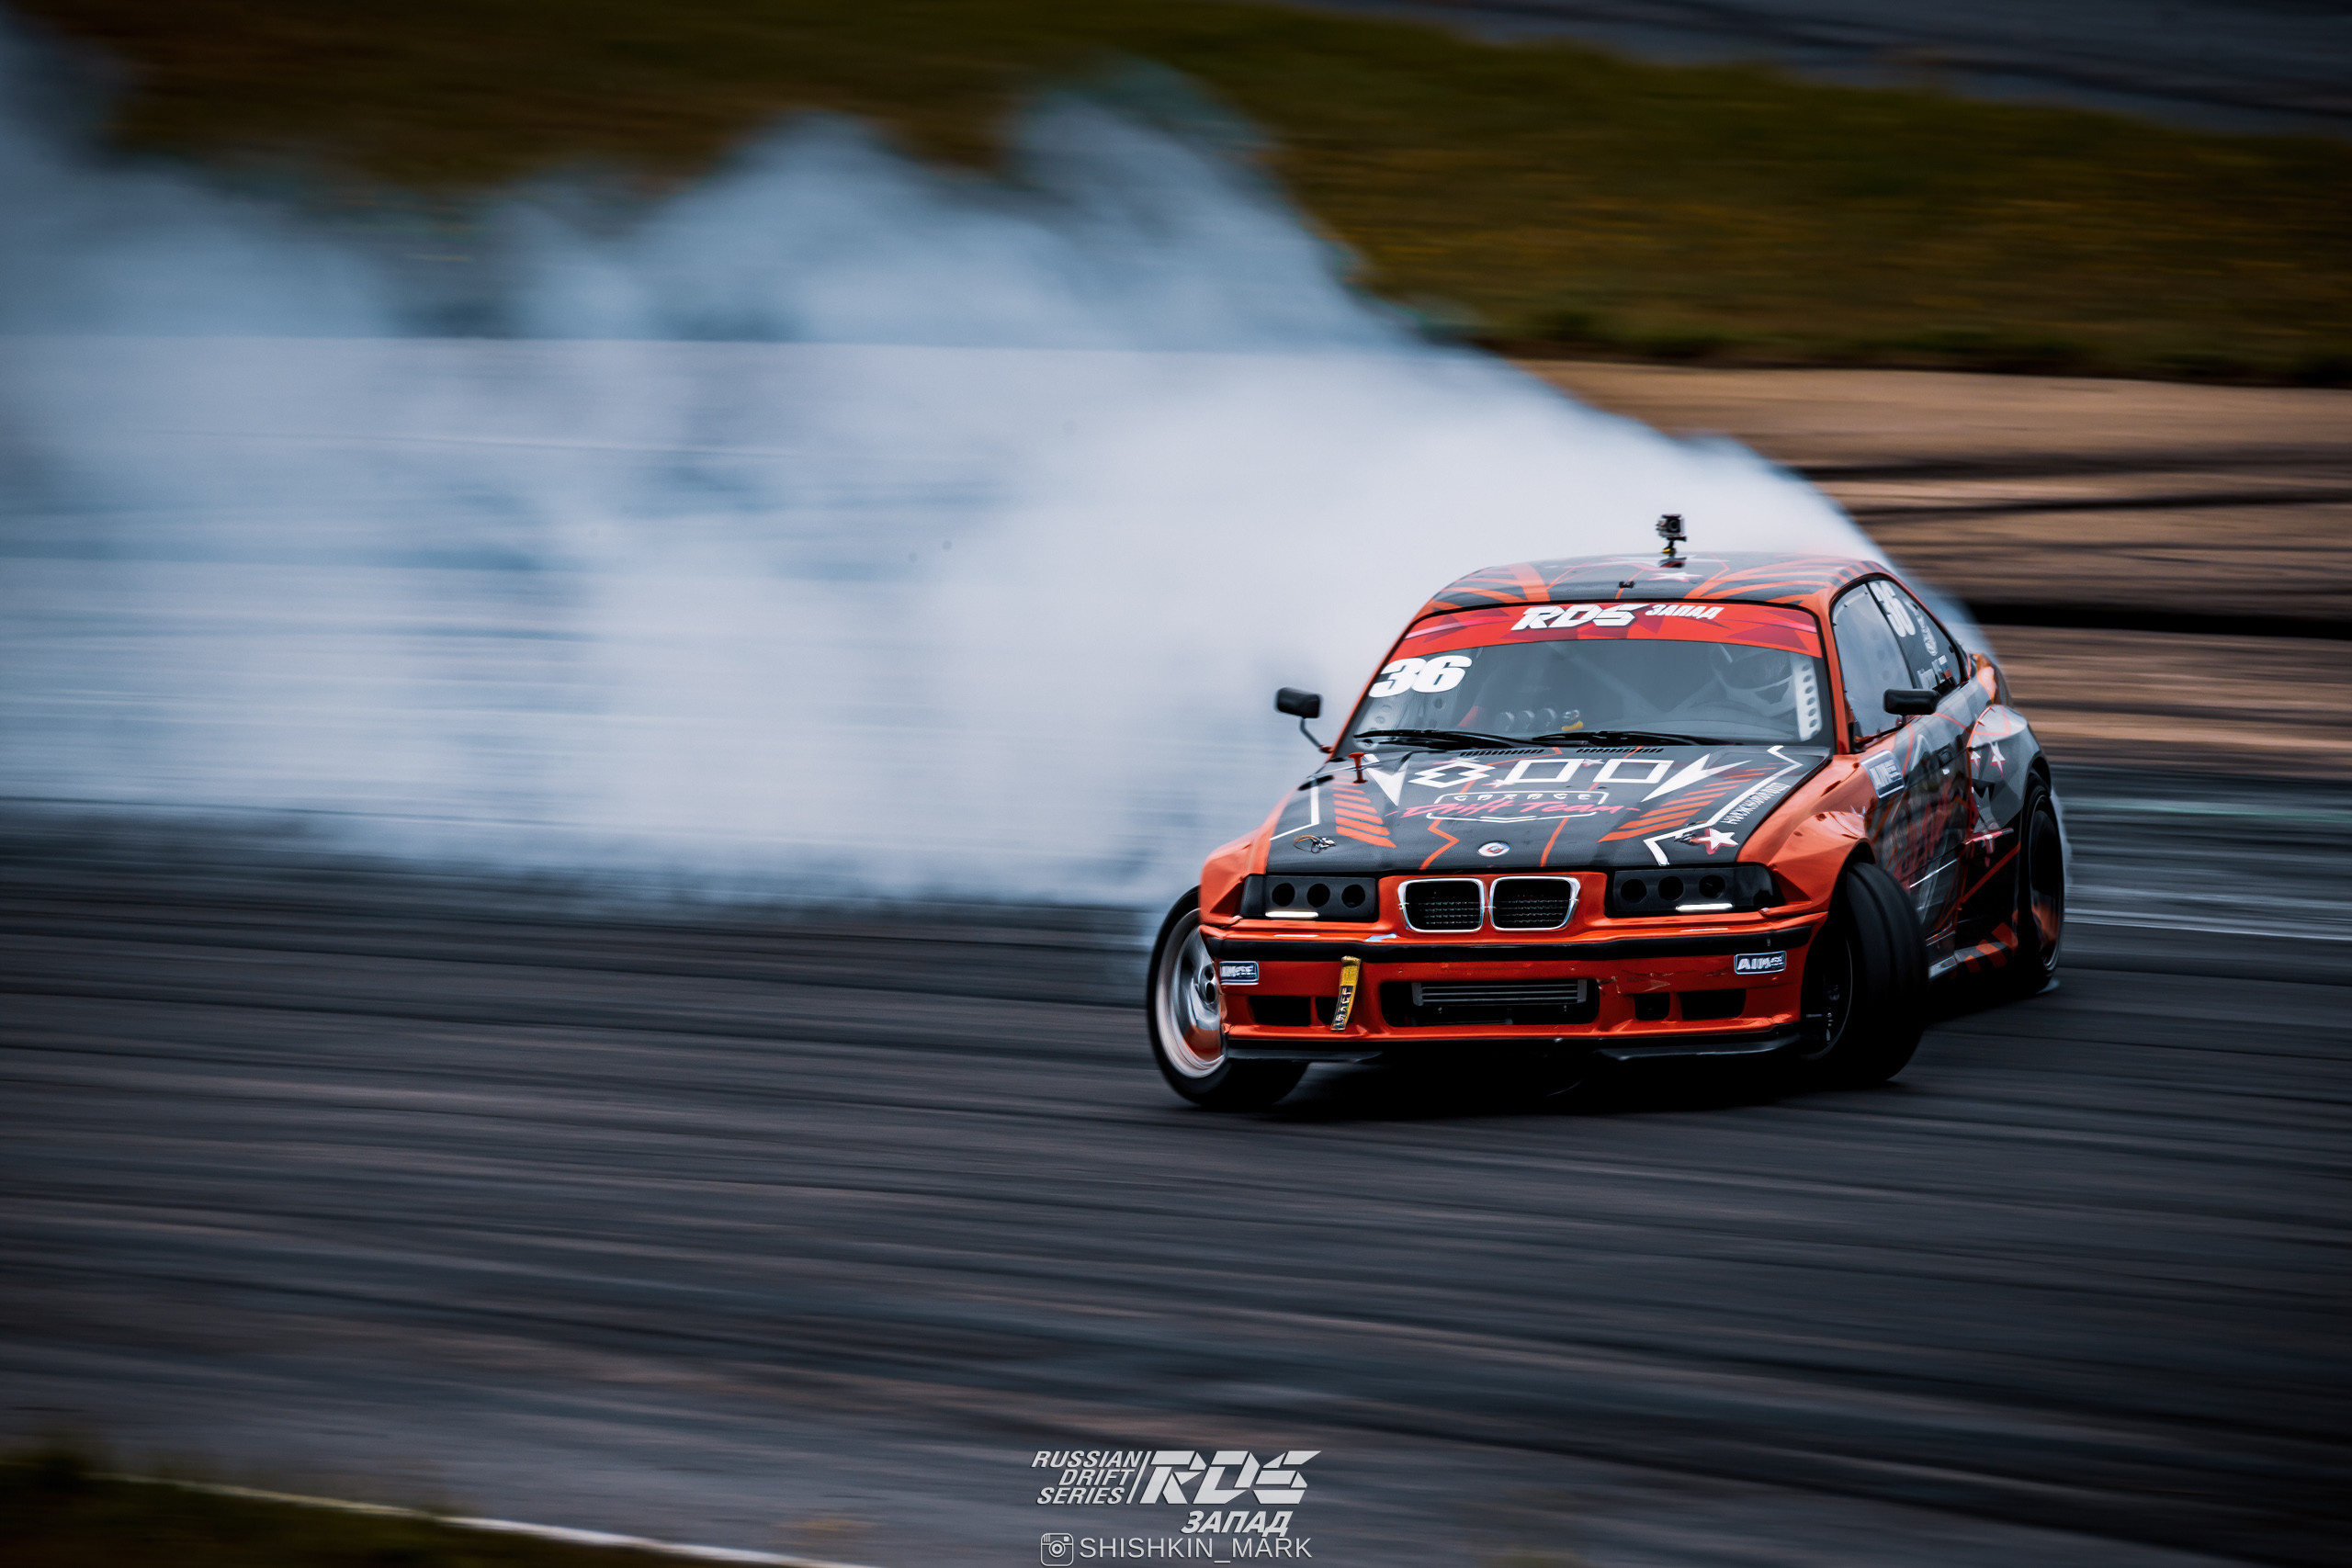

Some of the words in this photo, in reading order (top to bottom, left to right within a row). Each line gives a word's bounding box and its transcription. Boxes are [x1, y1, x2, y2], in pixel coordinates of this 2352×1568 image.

[1510, 603, 1650, 631] RDS
[1645, 604, 1725, 620] ЗАПАД
[1368, 654, 1473, 698] 36
